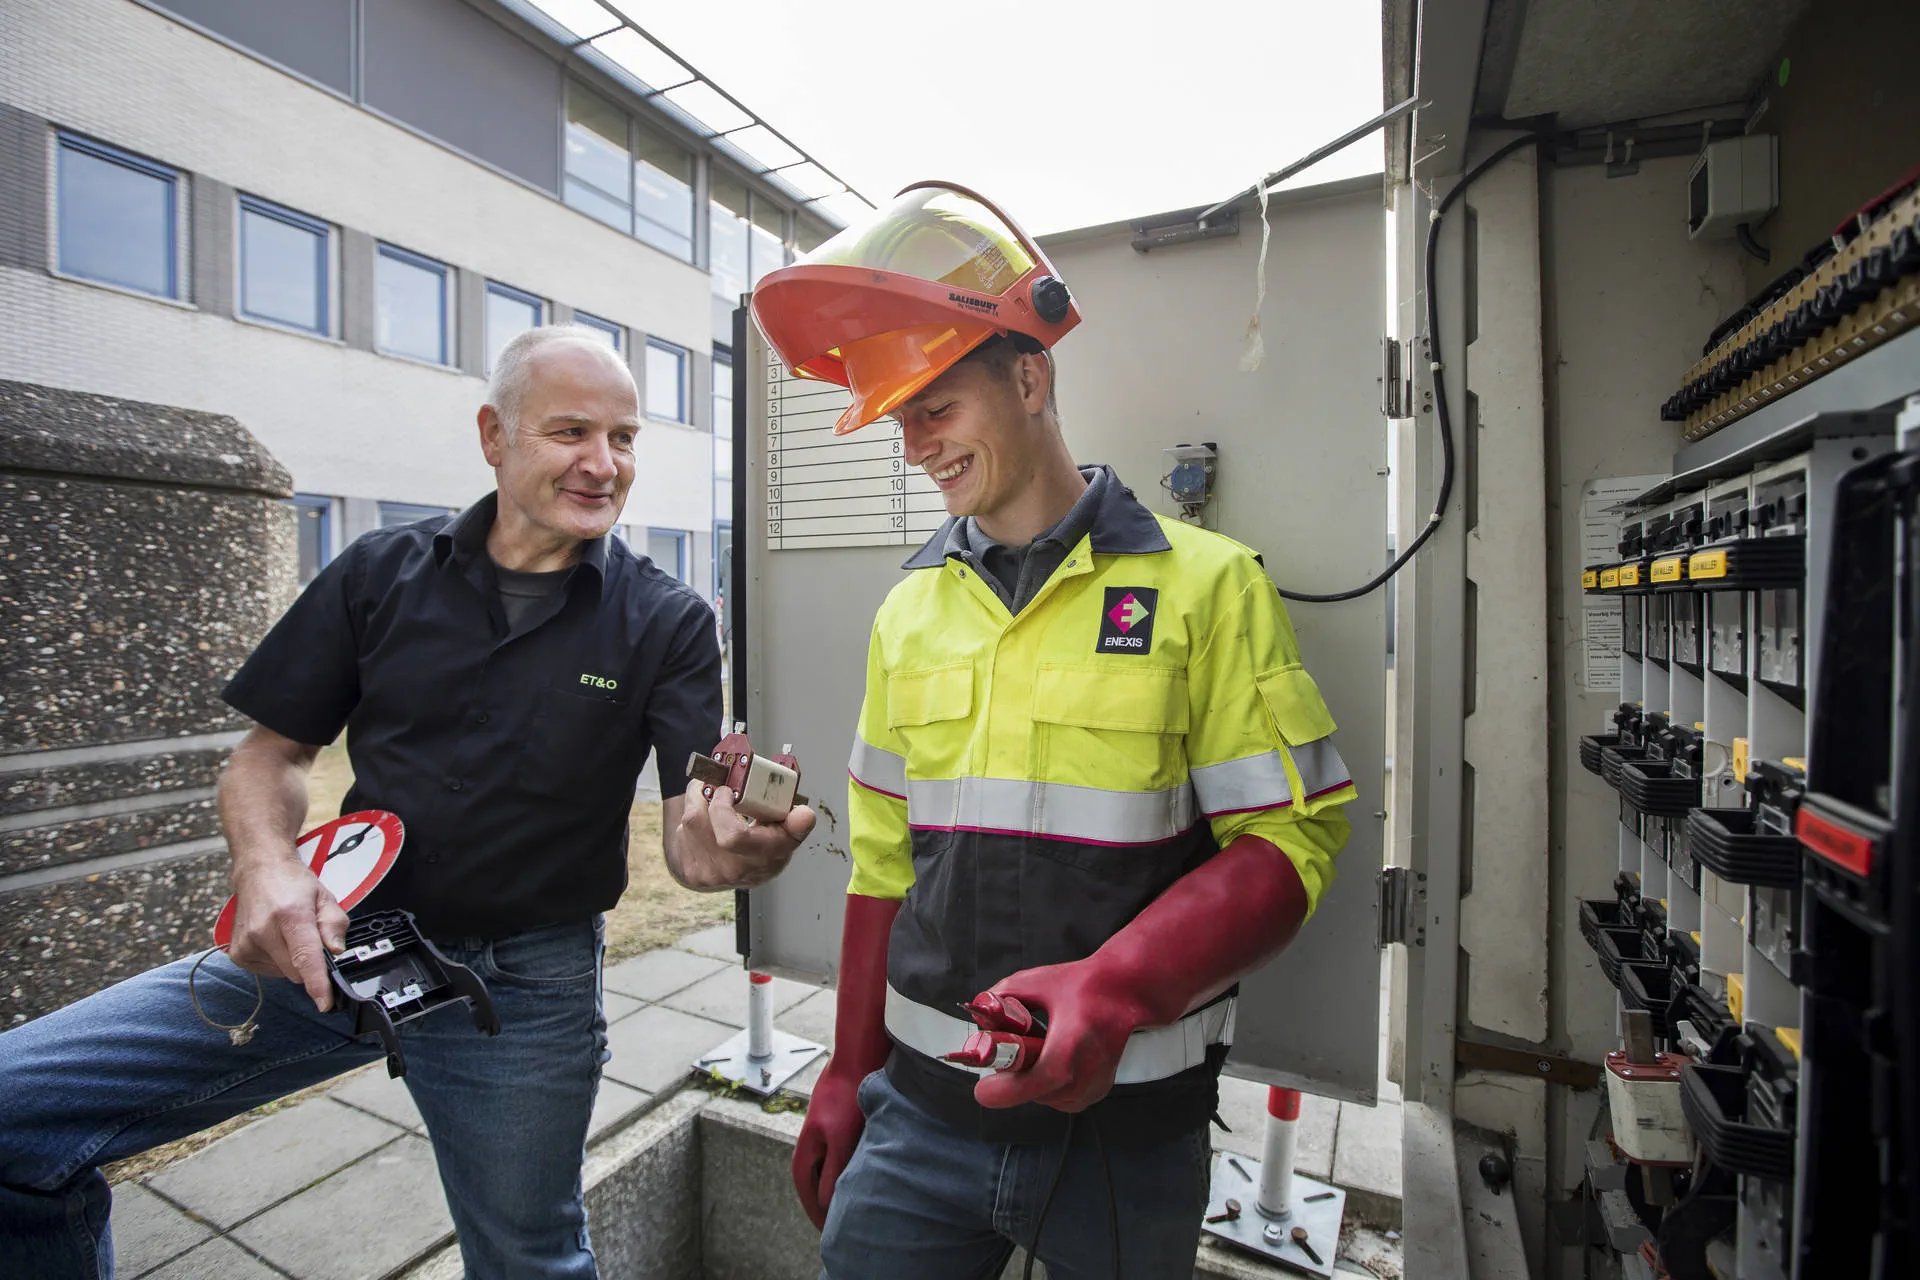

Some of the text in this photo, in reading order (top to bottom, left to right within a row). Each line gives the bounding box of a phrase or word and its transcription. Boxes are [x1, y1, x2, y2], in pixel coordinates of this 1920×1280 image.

[949, 293, 998, 309] SALISBURY
[771, 367, 777, 379] 3
[771, 384, 777, 396] 4
[771, 402, 777, 413] 5
[771, 419, 777, 431] 6
[771, 436, 777, 448] 7
[892, 441, 900, 453] 8
[770, 453, 777, 465] 8
[892, 460, 900, 472] 9
[770, 470, 777, 482] 9
[890, 478, 903, 491] 10
[769, 488, 780, 500] 10
[890, 497, 902, 509] 11
[769, 505, 779, 517] 11
[890, 515, 903, 528] 12
[769, 522, 780, 534] 12
[1104, 637, 1143, 648] ENEXIS
[580, 673, 617, 690] ET&O
